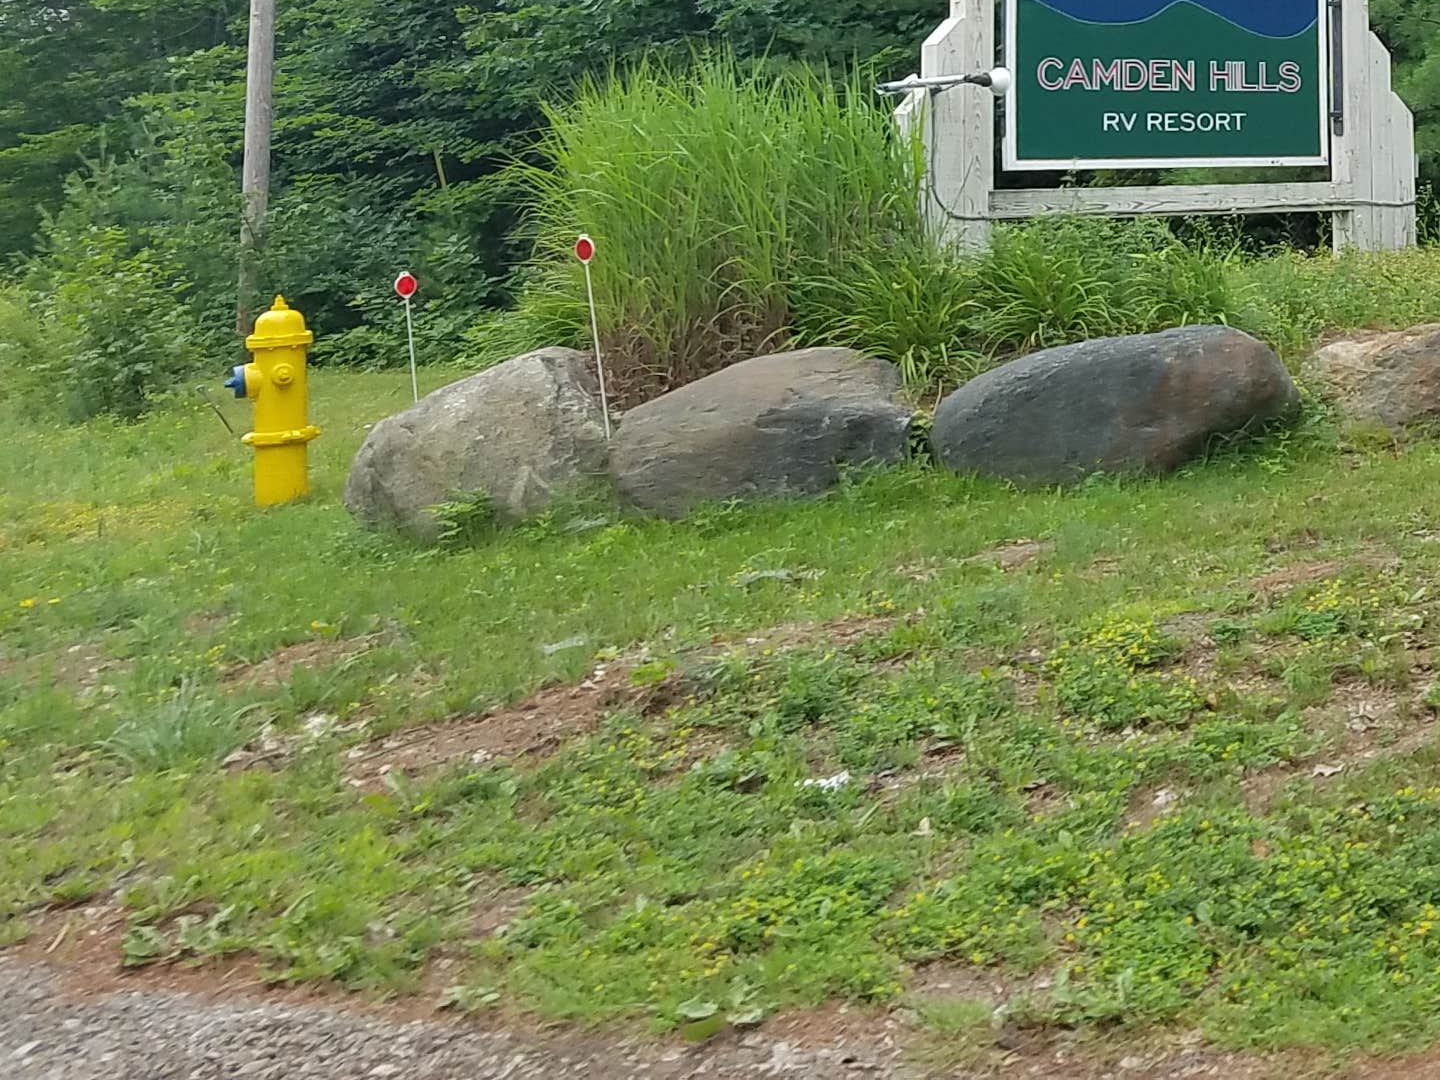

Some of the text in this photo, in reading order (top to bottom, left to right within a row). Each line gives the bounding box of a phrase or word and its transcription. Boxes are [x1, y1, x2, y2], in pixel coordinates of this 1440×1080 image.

[1037, 57, 1302, 93] CAMDEN HILLS
[1102, 112, 1247, 132] RV RESORT
